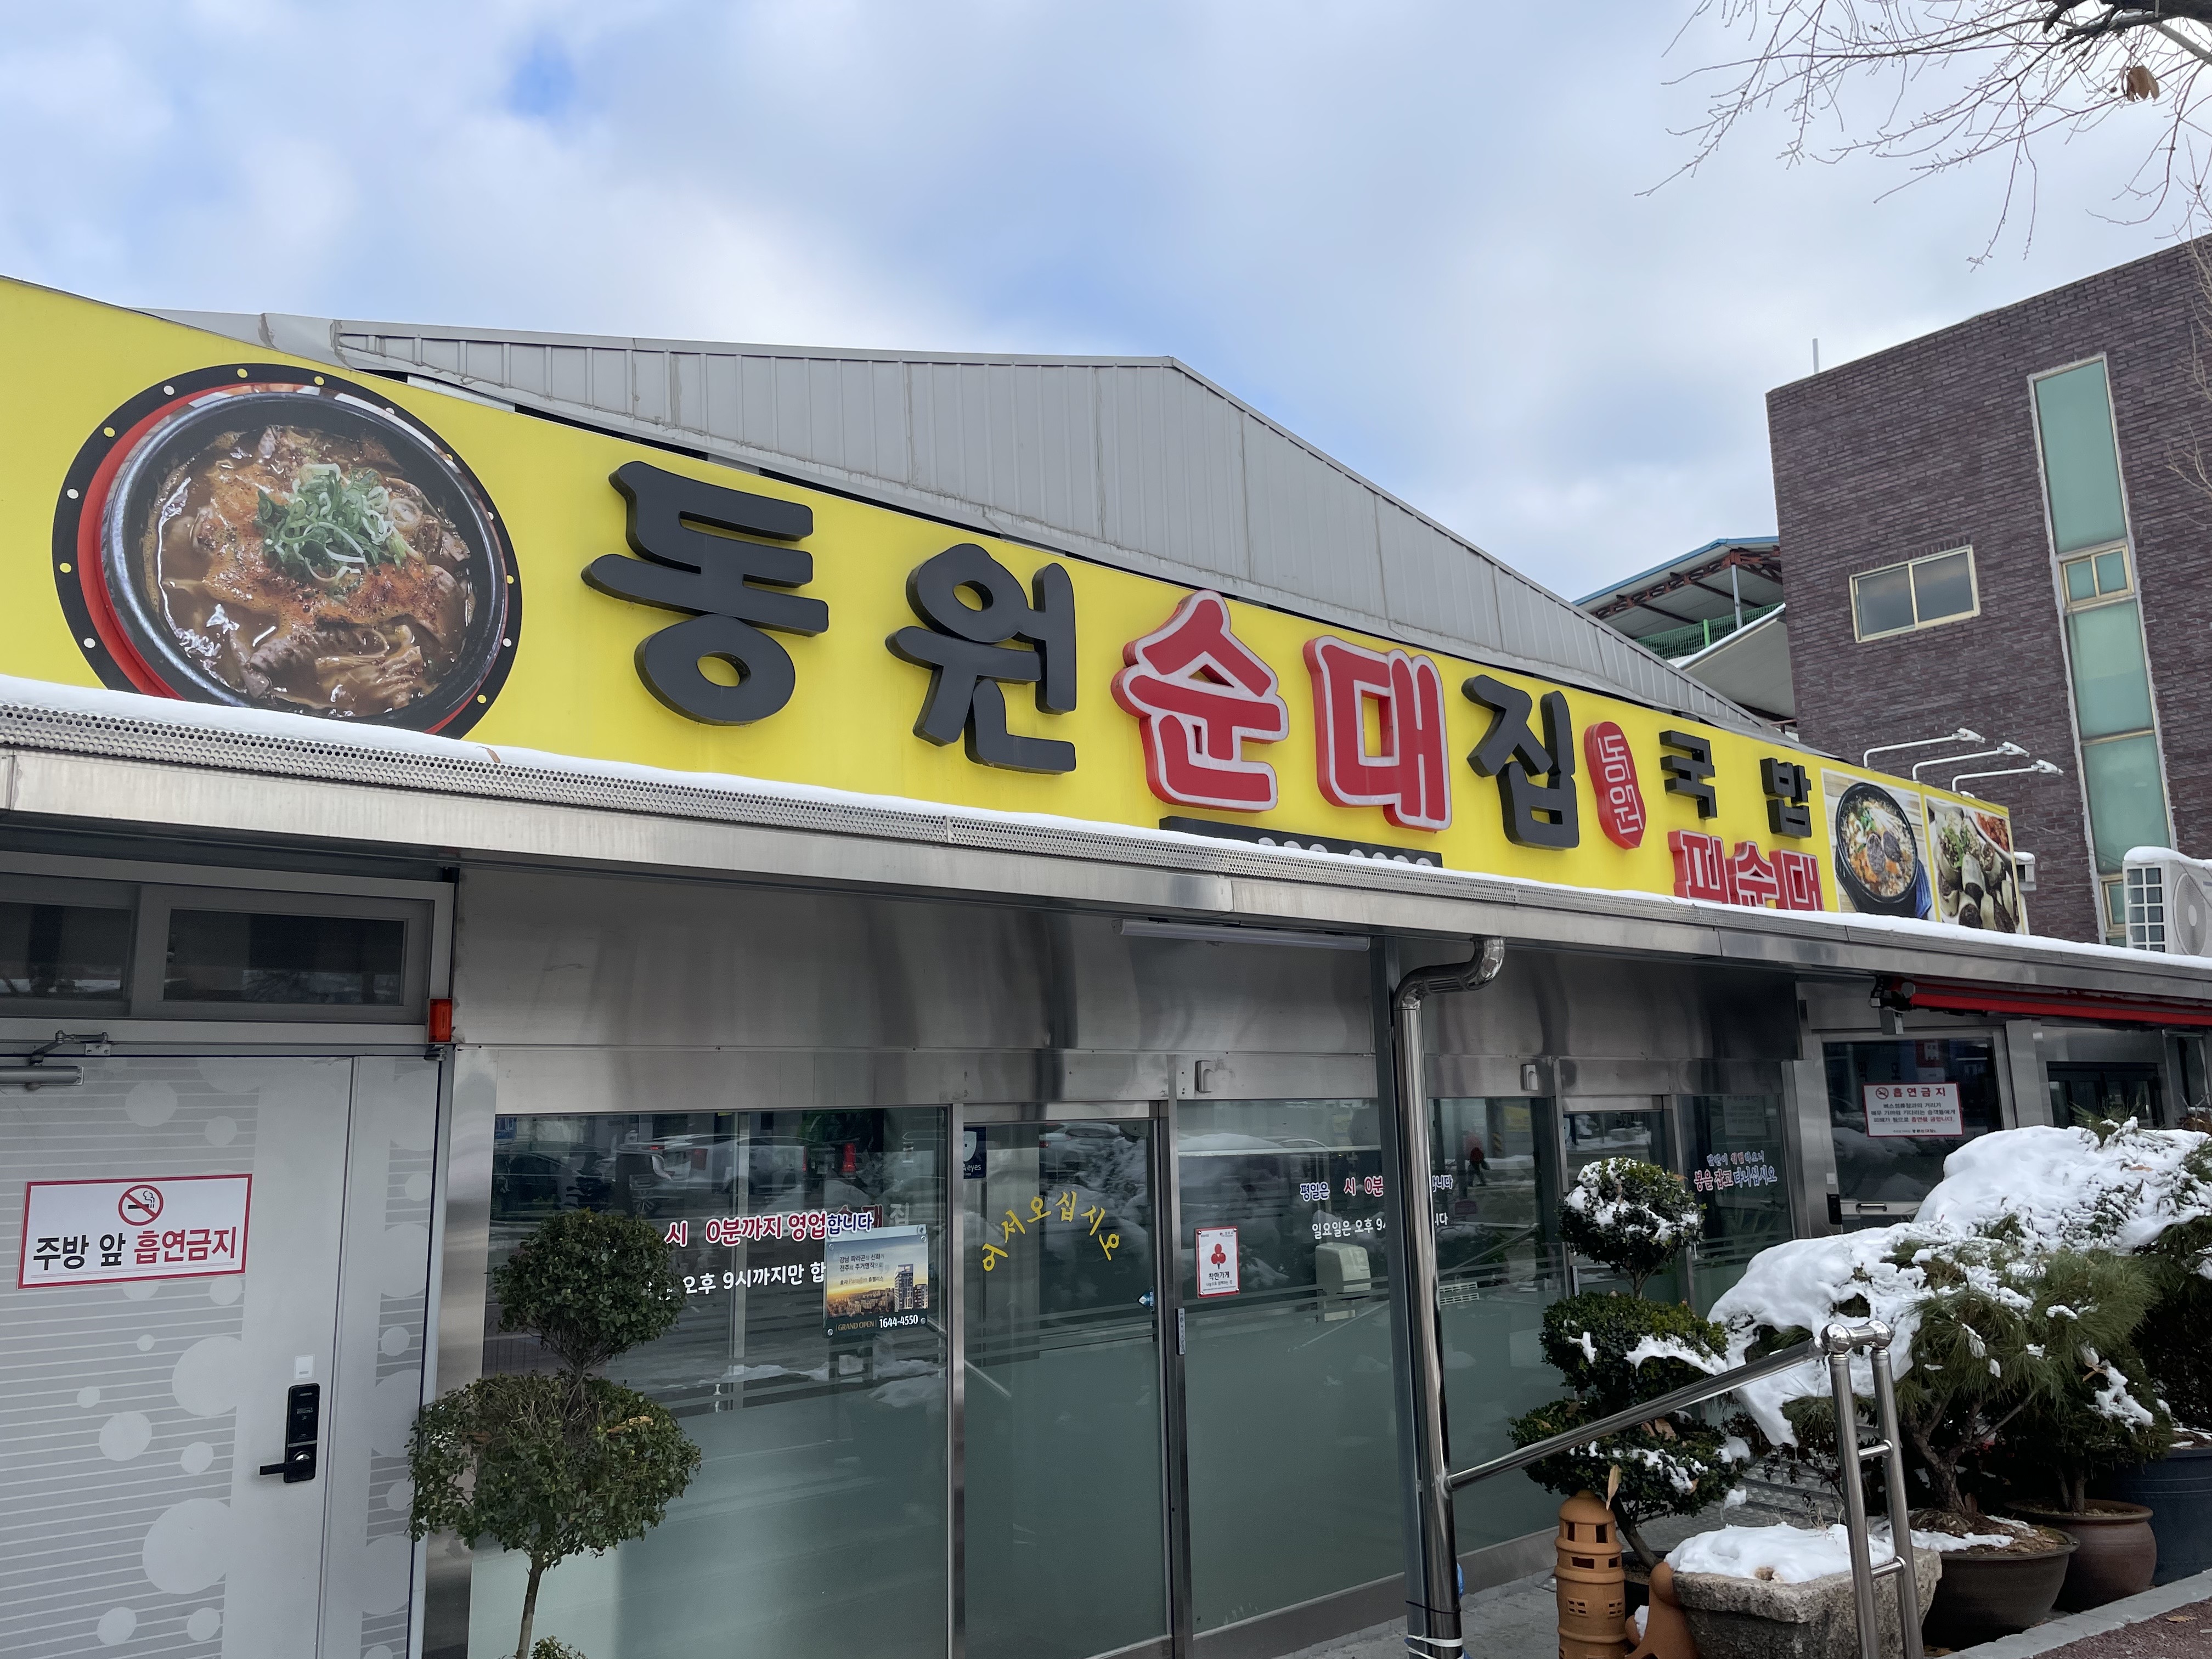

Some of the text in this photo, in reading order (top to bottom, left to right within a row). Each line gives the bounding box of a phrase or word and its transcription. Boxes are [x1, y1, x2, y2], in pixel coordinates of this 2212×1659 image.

[1893, 1087, 1946, 1097] 흡연금지
[1300, 1181, 1330, 1201] 평일은
[1343, 1177, 1357, 1197] 시
[1694, 1164, 1778, 1192] 봉을 잡고 다니십시오
[664, 1220, 688, 1247] 시
[706, 1214, 783, 1247] 0분까지
[1312, 1220, 1351, 1240] 일요일은
[1355, 1218, 1374, 1234] 오후
[33, 1226, 237, 1271] 주방 앞 흡연금지
[682, 1272, 716, 1294] 오후
[723, 1263, 805, 1289] 9시까지만
[1209, 1271, 1229, 1280] 착한가게
[838, 1314, 918, 1331] GRAND OPEN 1644-4550
